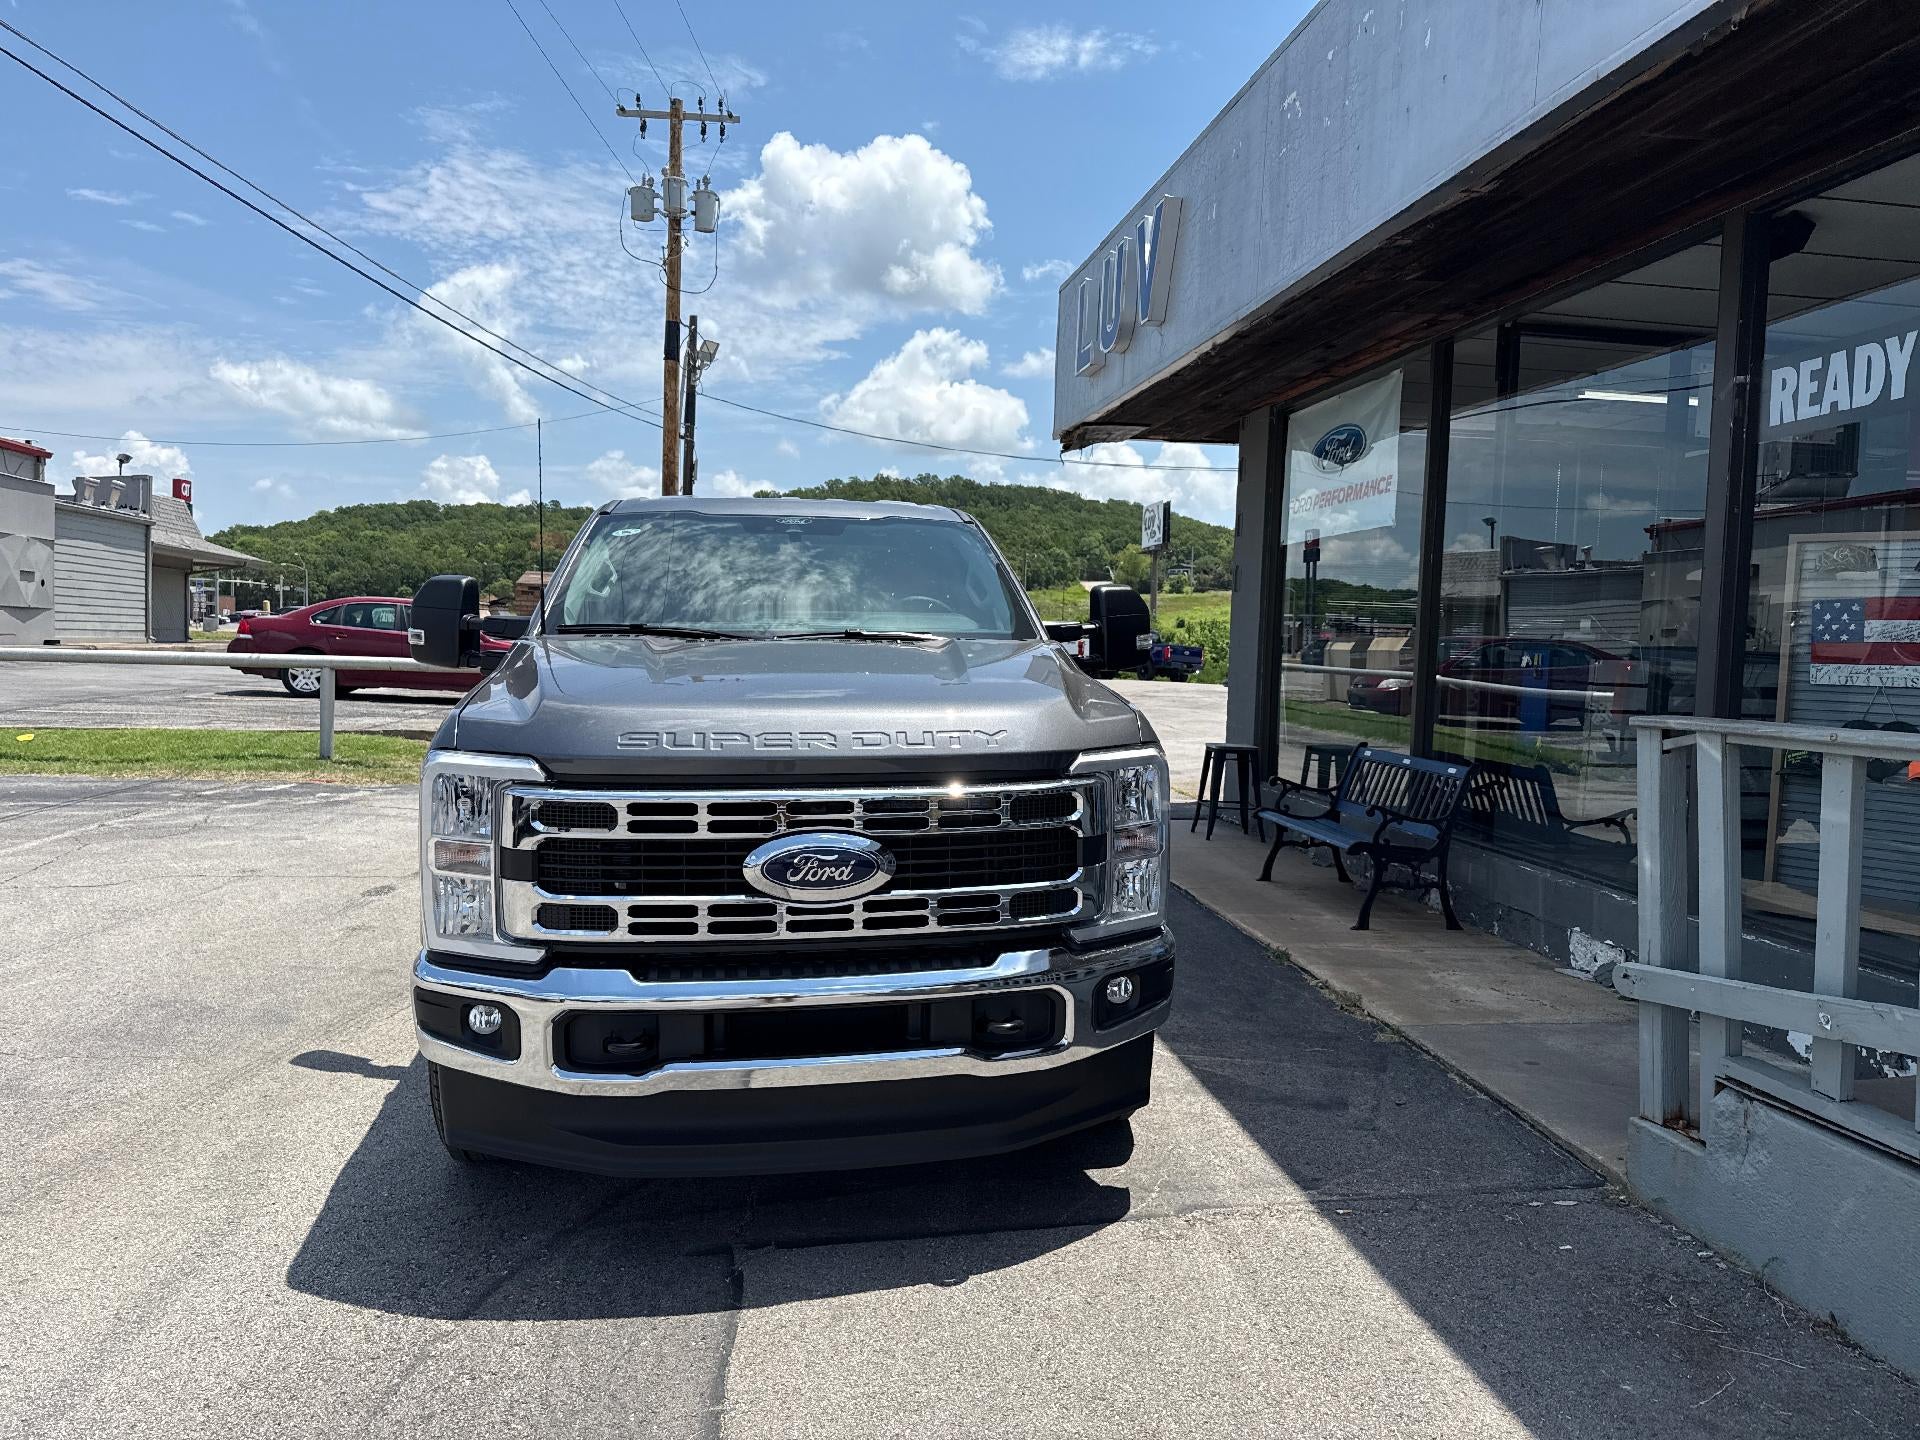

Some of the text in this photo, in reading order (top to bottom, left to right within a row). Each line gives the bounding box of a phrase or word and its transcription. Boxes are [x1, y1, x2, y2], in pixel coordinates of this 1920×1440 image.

[1075, 195, 1183, 376] LUV
[1769, 330, 1919, 427] READY
[1318, 432, 1356, 466] Ford
[181, 483, 190, 497] QT
[1313, 474, 1394, 510] PERFORMANCE
[617, 729, 1008, 751] SUPER DUTY
[786, 853, 854, 882] Ford
